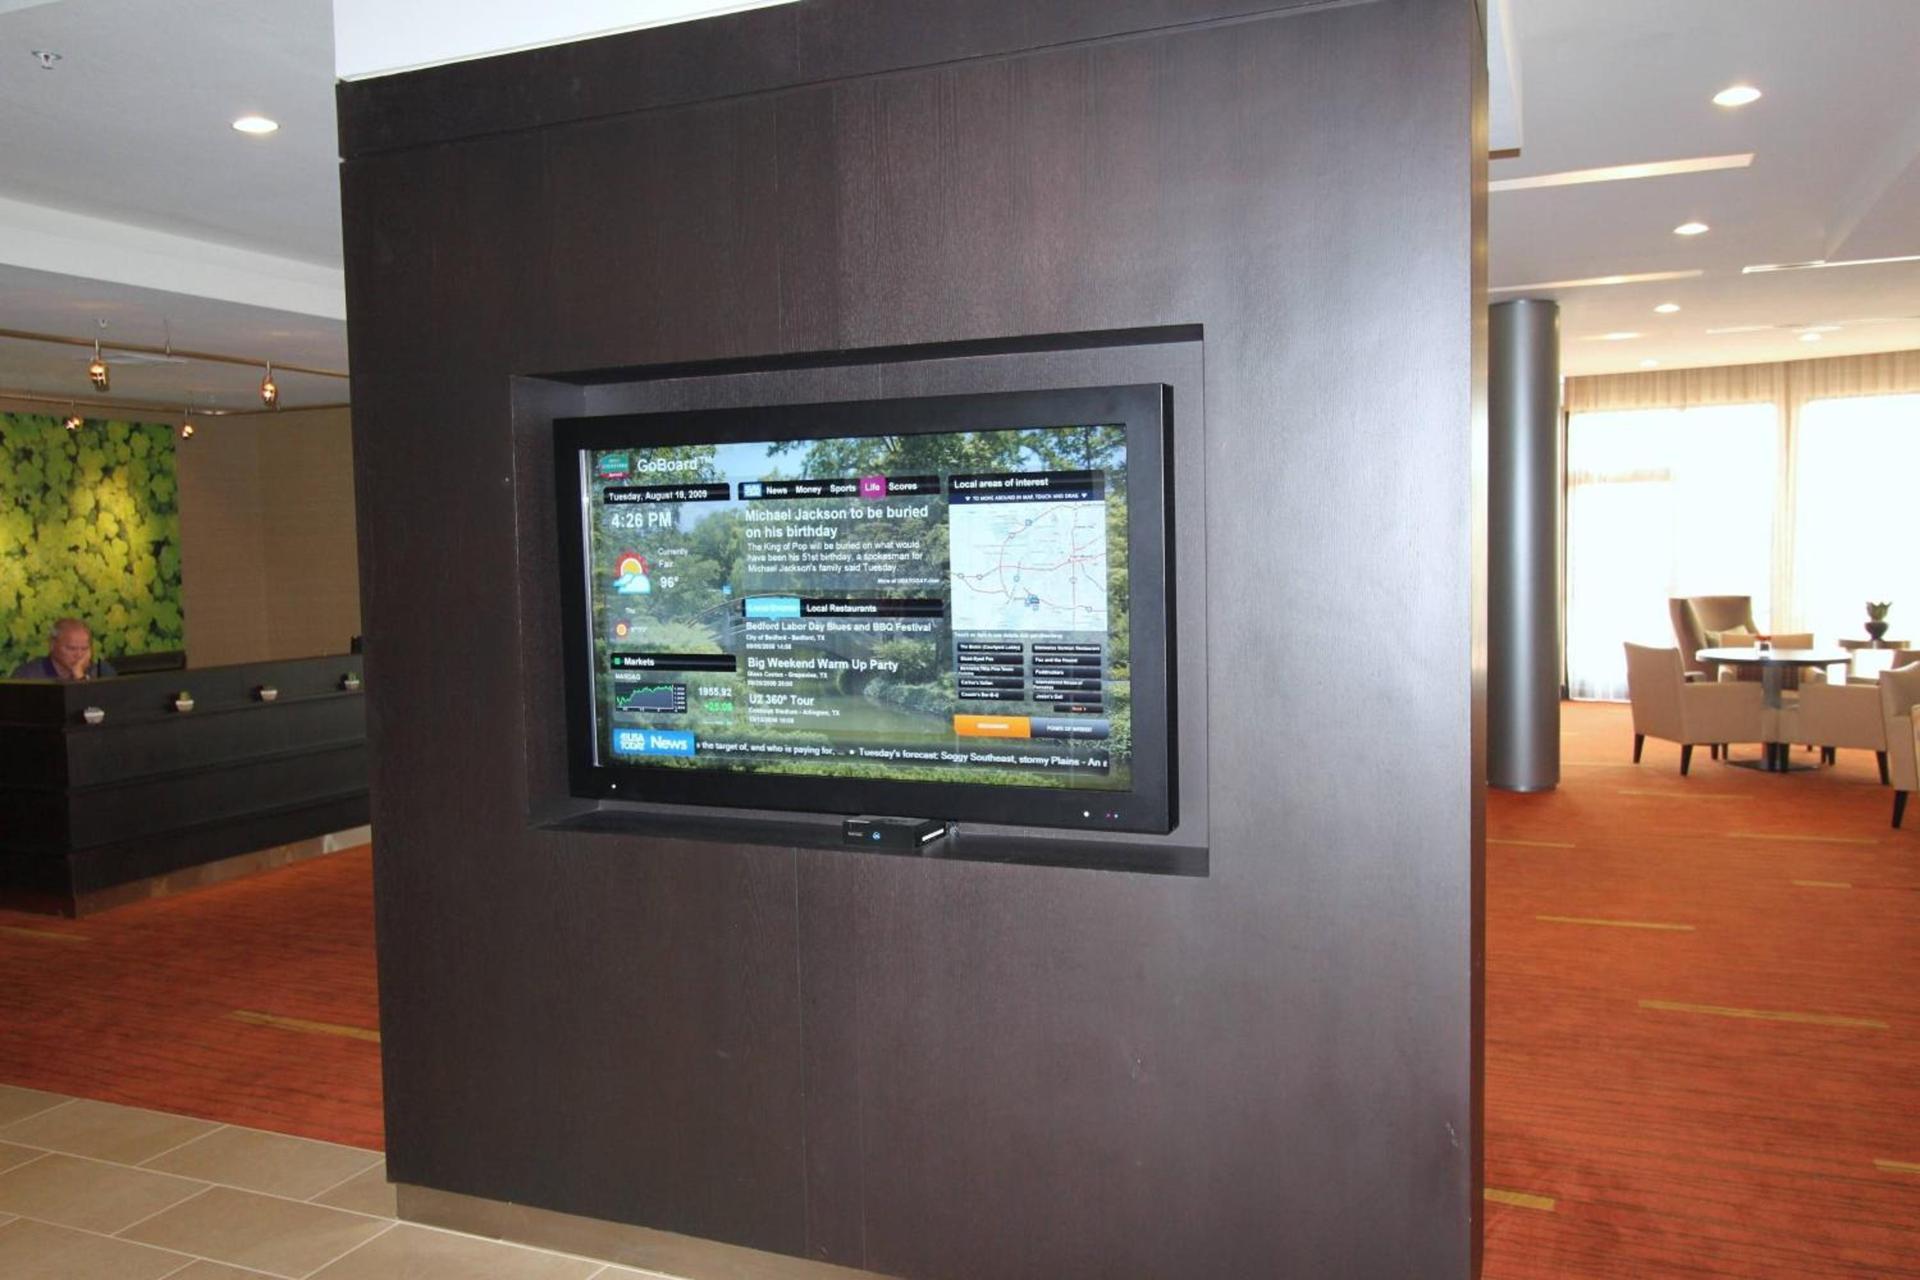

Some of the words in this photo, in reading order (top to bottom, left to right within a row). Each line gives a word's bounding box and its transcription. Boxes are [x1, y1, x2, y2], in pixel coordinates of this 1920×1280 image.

[766, 486, 788, 495] News
[795, 485, 822, 495] Money
[830, 483, 857, 494] Sports
[865, 482, 880, 492] Life
[888, 481, 918, 492] Scores
[954, 479, 978, 489] Local
[979, 480, 1002, 488] areas
[1005, 478, 1014, 487] of
[1015, 477, 1049, 487] interest
[609, 492, 643, 502] Tuesday,
[645, 490, 673, 501] August
[689, 489, 708, 499] 2009
[611, 513, 643, 528] 4:26
[648, 511, 672, 528] PM
[745, 508, 792, 522] Michael
[795, 507, 847, 521] Jackson
[850, 508, 864, 519] to
[867, 506, 884, 519] be
[886, 505, 930, 518] buried
[745, 528, 761, 538] on
[764, 525, 784, 538] his
[786, 524, 838, 539] birthday
[747, 542, 762, 551] The
[763, 542, 781, 552] King
[783, 542, 791, 550] of
[792, 542, 808, 551] Pop
[809, 541, 822, 550] will
[823, 542, 834, 550] be
[835, 540, 860, 550] buried
[874, 541, 894, 549] what
[895, 540, 920, 549] would
[747, 554, 766, 562] have
[767, 553, 787, 561] been
[788, 553, 800, 561] his
[820, 552, 853, 562] birthday,
[863, 552, 910, 561] spokesman
[911, 551, 923, 560] for
[659, 560, 674, 568] Fair
[748, 564, 777, 572] Michael
[779, 563, 817, 572] Jackson's
[819, 563, 842, 573] family
[844, 563, 861, 571] said
[806, 604, 828, 613] Local
[830, 603, 877, 613] Restaurants
[746, 621, 779, 631] Bedford
[781, 621, 807, 631] Labor
[808, 621, 825, 632] Day
[827, 621, 852, 631] Blues
[854, 622, 870, 631] and
[872, 622, 893, 632] BBQ
[895, 622, 931, 632] Festival
[624, 657, 655, 667] Markets
[748, 657, 765, 670] Big
[767, 658, 815, 669] Weekend
[817, 658, 849, 669] Warm
[851, 659, 868, 671] Up
[870, 660, 899, 673] Party
[790, 694, 815, 706] Tour
[650, 736, 688, 751] News
[702, 741, 714, 750] the
[715, 742, 738, 752] target
[750, 743, 766, 752] and
[766, 745, 783, 753] who
[785, 745, 792, 753] is
[794, 746, 820, 756] paying
[859, 747, 901, 760] Tuesday's
[940, 751, 968, 763] Soggy
[970, 752, 1017, 764] Southeast,
[1019, 755, 1050, 767] stormy
[1051, 756, 1080, 767] Plains
[1088, 758, 1101, 767] An
